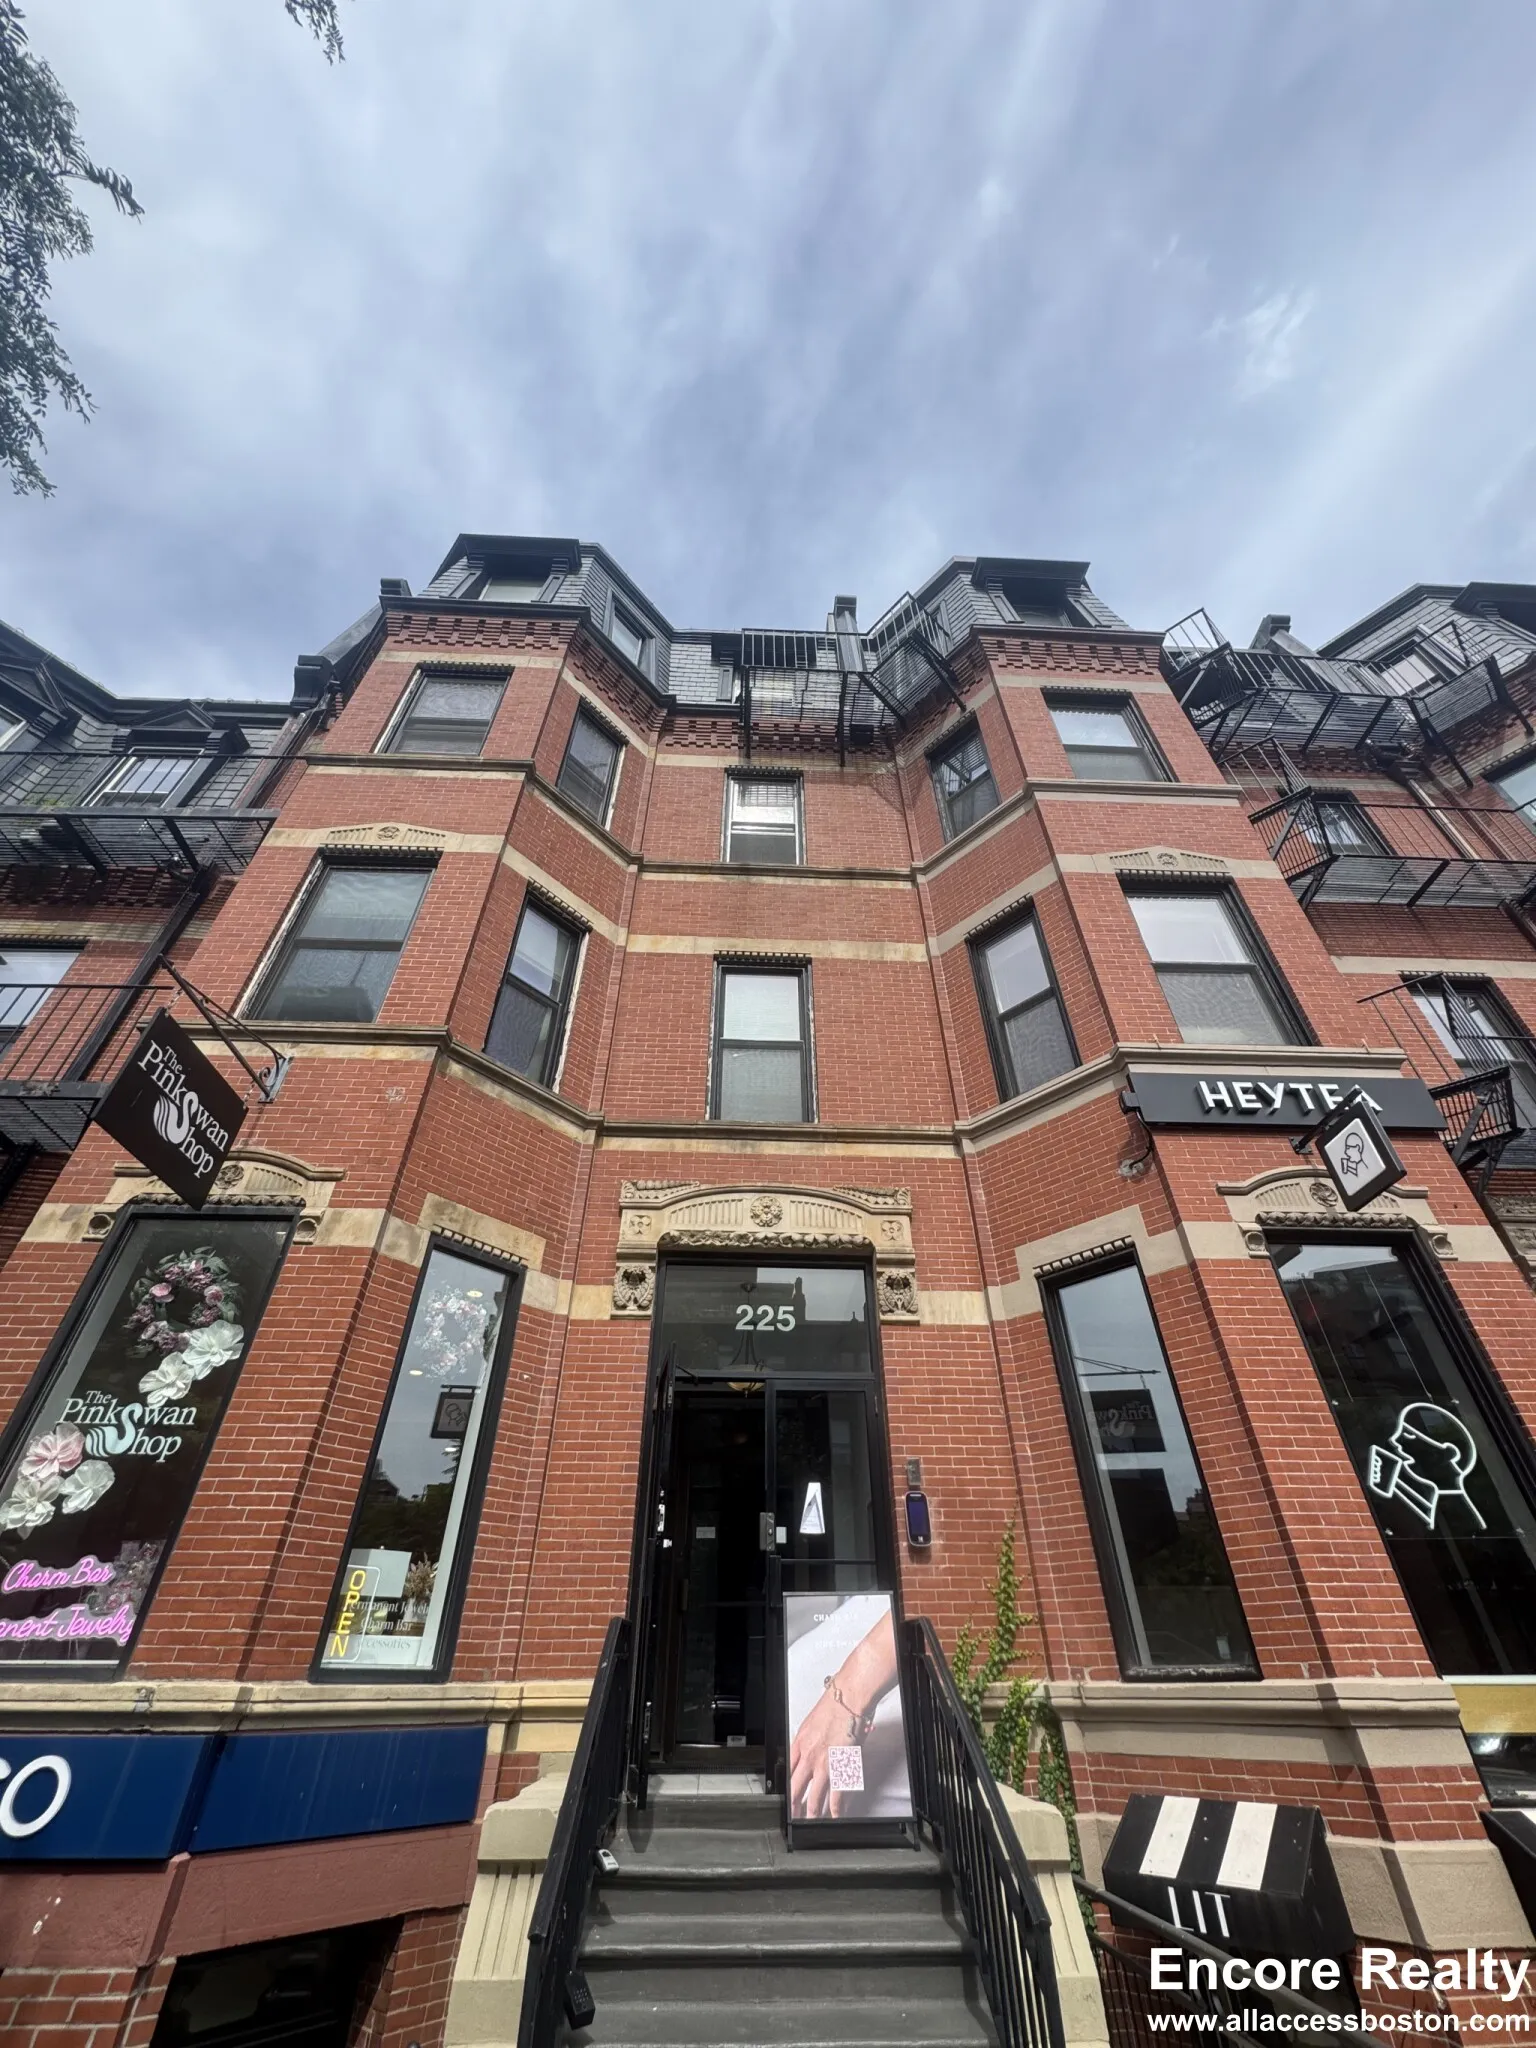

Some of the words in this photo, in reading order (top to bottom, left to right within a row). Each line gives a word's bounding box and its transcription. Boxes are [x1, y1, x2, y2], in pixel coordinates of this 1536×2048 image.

[138, 1040, 188, 1106] Pink
[163, 1046, 182, 1072] The
[735, 1304, 796, 1332] 225
[54, 1398, 124, 1424] Pink
[85, 1390, 112, 1404] The
[3, 1562, 71, 1591] Charm
[72, 1557, 113, 1584] Bar
[57, 1604, 133, 1643] Jewelry
[330, 1569, 366, 1657] OPEN
[1168, 1886, 1231, 1938] LIT
